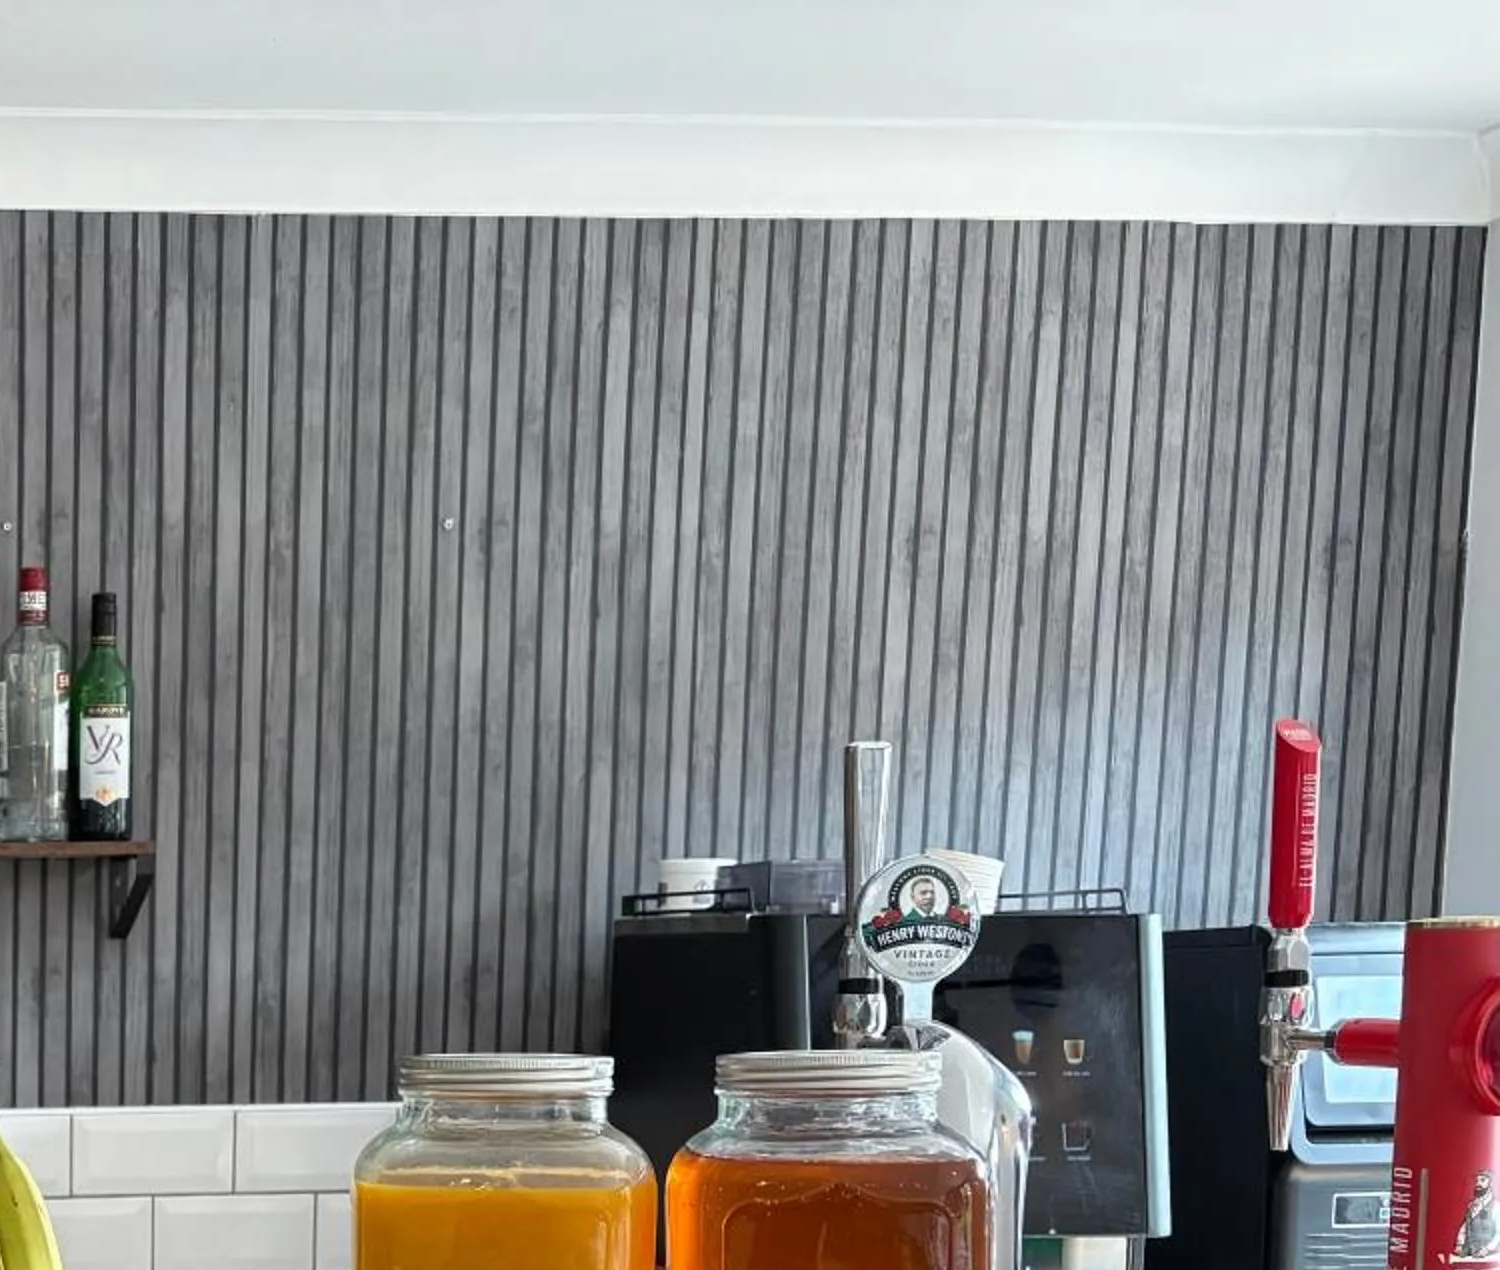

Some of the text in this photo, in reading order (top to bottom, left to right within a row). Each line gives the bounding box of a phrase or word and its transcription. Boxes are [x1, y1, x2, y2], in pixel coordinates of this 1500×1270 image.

[877, 927, 915, 946] HENRY
[894, 949, 951, 960] VINTAGE
[1390, 1166, 1414, 1253] MADRID
